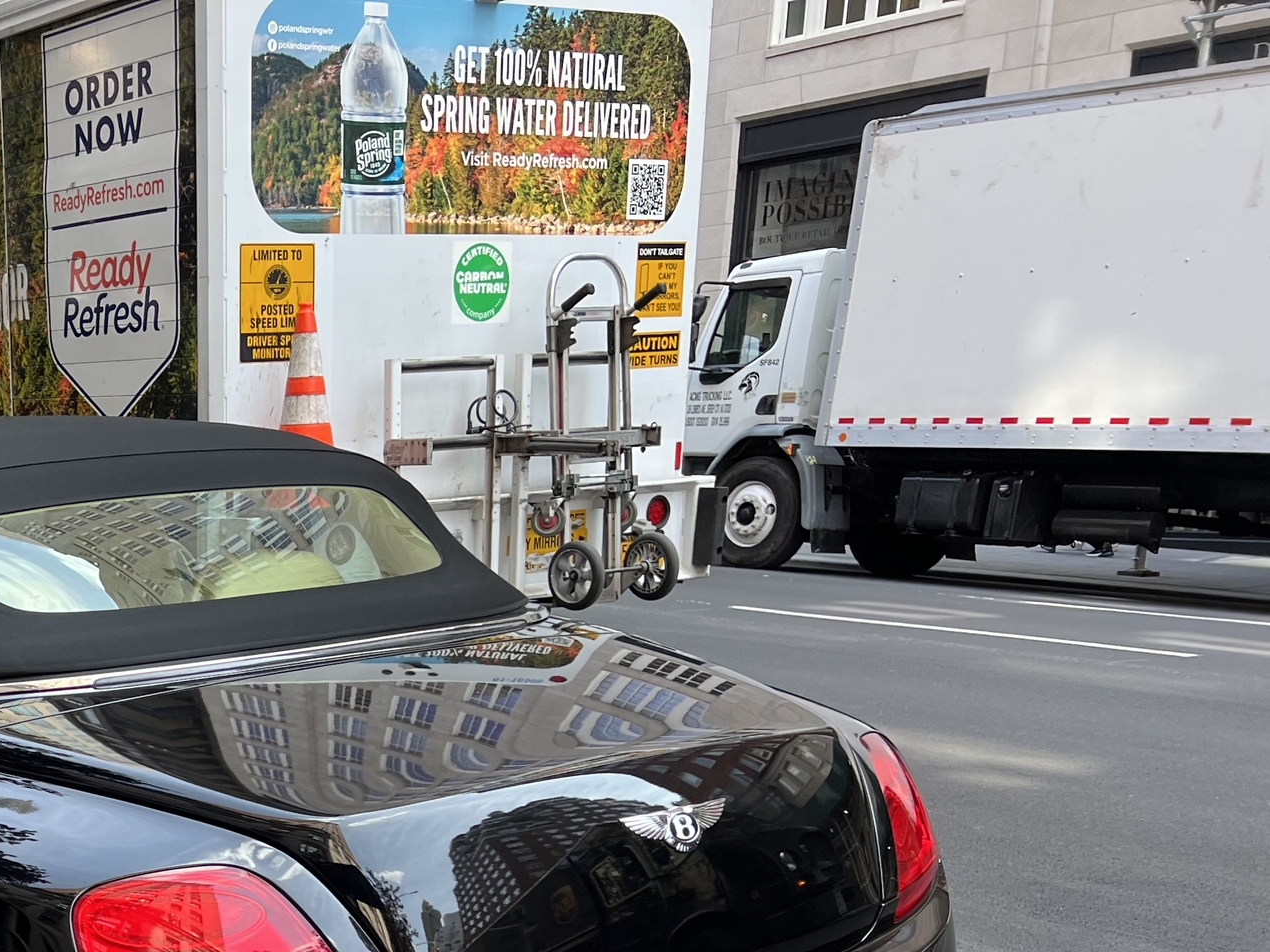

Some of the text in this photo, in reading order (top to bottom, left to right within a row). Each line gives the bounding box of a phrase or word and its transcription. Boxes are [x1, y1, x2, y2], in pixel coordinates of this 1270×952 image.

[279, 24, 334, 36] polandspringwtr
[278, 42, 341, 53] polandspringwater
[454, 44, 626, 92] GET 100% NATURAL
[65, 60, 153, 116] ORDER
[420, 94, 652, 140] SPRING WATER DELIVERED
[75, 107, 144, 157] NOW
[355, 131, 390, 156] Poland
[356, 148, 392, 171] Spring
[461, 151, 608, 170] Visit ReadyRefresh.com
[53, 178, 165, 213] ReadyRefresh.com
[761, 194, 847, 227] POSSIB
[253, 249, 302, 261] LIMITED TO
[461, 246, 503, 266] CERTIFIED
[639, 247, 683, 256] DON'T TAILGATE
[69, 240, 151, 294] Ready
[658, 262, 677, 270] IF YOU
[456, 271, 504, 284] CARBON
[658, 272, 676, 280] CAN'T
[668, 282, 677, 290] MY
[64, 286, 159, 338] Refresh
[261, 304, 294, 316] POSTED
[639, 302, 655, 312] AN'T
[656, 303, 666, 311] SEE
[466, 308, 495, 321] company
[250, 316, 296, 329] SPEED LIM
[247, 335, 278, 347] DRIVER
[252, 347, 291, 359] MONITOR
[630, 354, 678, 366] IDE TURNS
